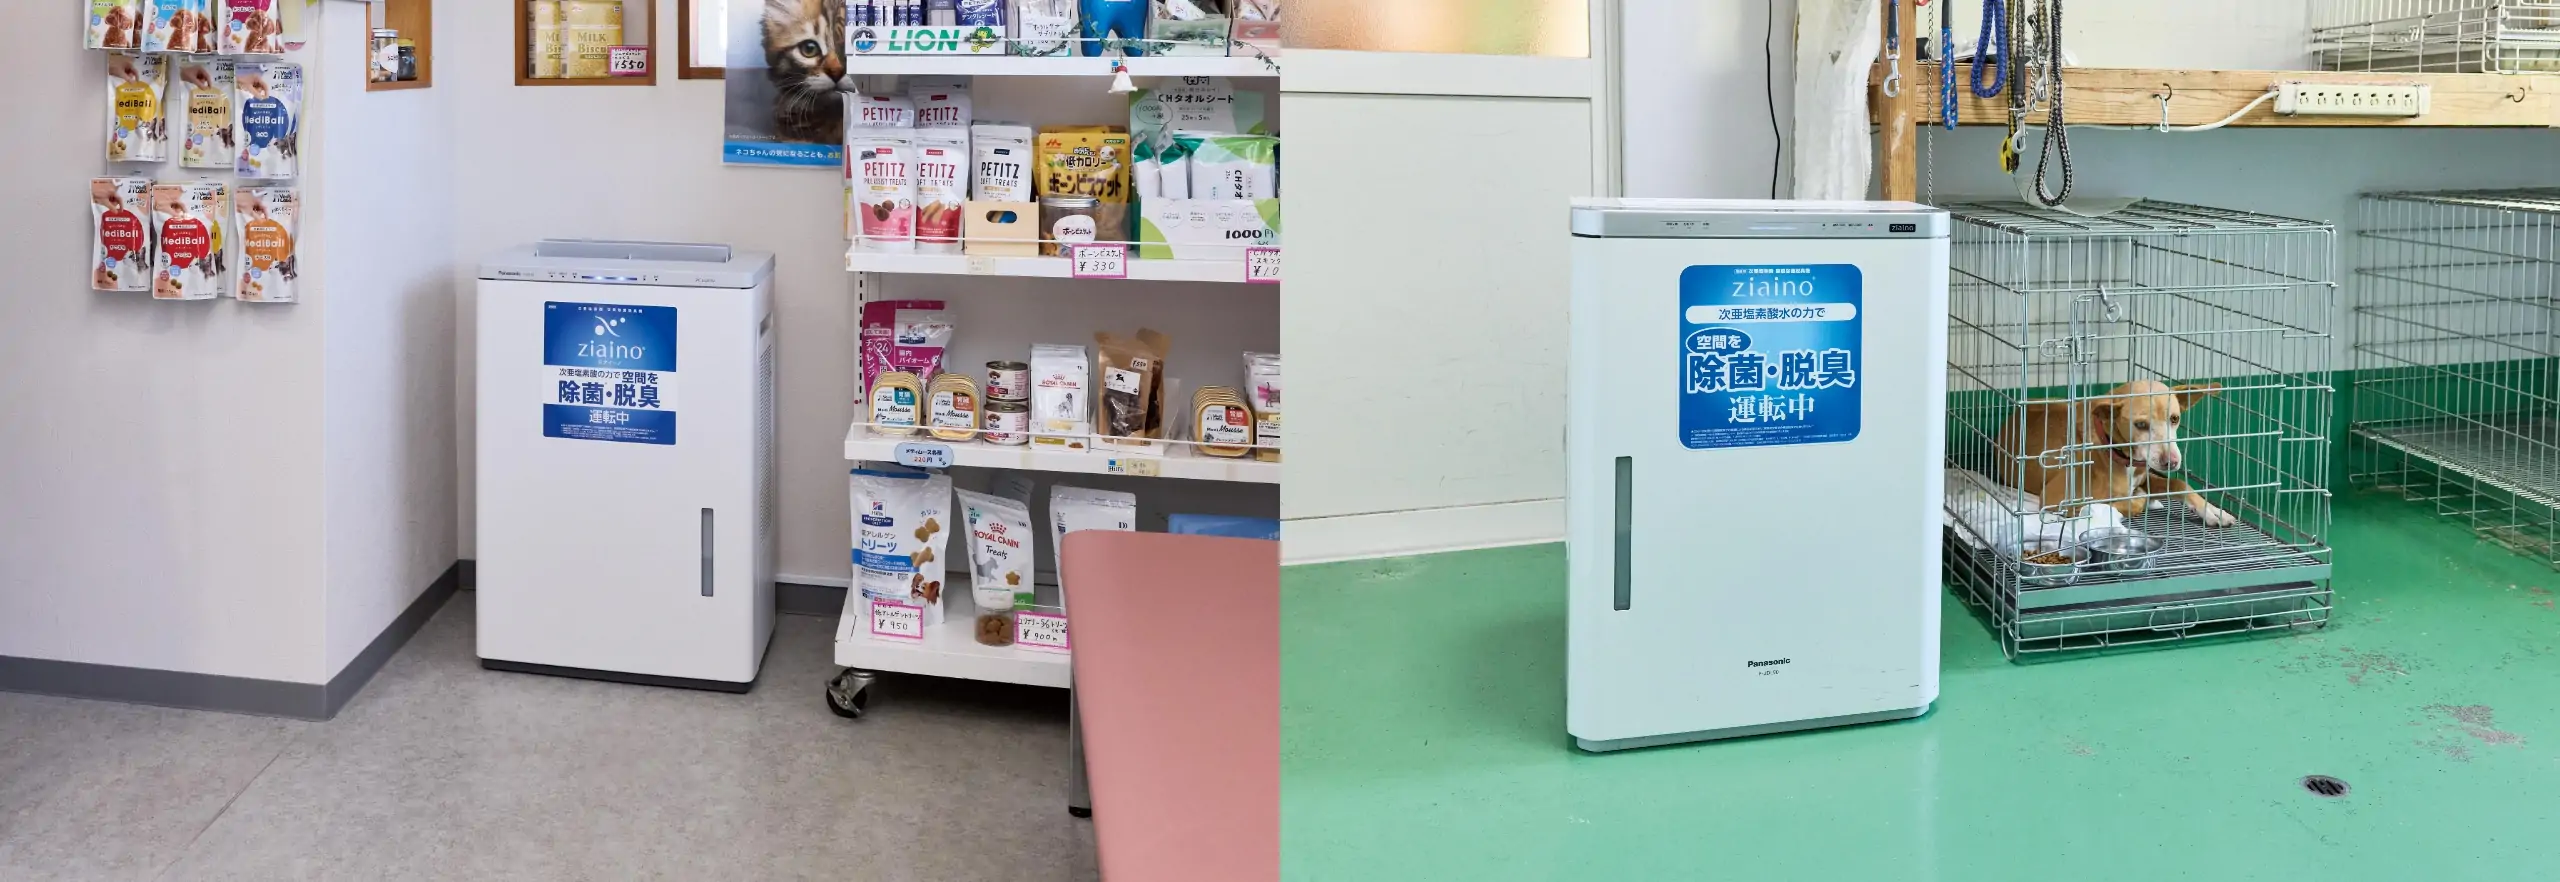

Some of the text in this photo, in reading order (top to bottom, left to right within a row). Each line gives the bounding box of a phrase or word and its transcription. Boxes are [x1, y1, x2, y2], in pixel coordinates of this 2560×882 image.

[545, 33, 561, 42] MI
[577, 33, 607, 42] MILK
[888, 29, 960, 51] LION
[578, 44, 609, 53] Biscu
[614, 60, 645, 70] ¥550
[119, 99, 152, 108] ediBall
[1158, 94, 1235, 104] CHタオルシート
[863, 107, 903, 121] PETITZ
[919, 107, 959, 122] PETITZ
[864, 162, 905, 177] PETITZ
[1066, 156, 1107, 168] 低カロリー
[917, 163, 956, 179] ETITZ
[981, 162, 1020, 179] PETITZ
[1078, 248, 1124, 258] ボーンビスケット
[1732, 277, 1814, 297] ziaino
[1718, 307, 1826, 321] 次亜塩素酸水の力で
[1696, 334, 1742, 350] 空間を
[577, 340, 643, 360] ziaino
[559, 368, 659, 385] 次亜塩素酸の力で 空間を
[1688, 349, 1854, 392] 除菌・脱臭
[558, 380, 661, 409] 除菌・脱臭
[889, 405, 911, 413] Mousse
[946, 410, 970, 418] Mousse
[1728, 393, 1815, 424] 運転中
[589, 409, 630, 426] 運転中
[1219, 425, 1244, 434] Mousse
[861, 538, 897, 553] トリーツ
[974, 530, 1019, 549] ROYAL CANIN
[986, 545, 1008, 560] Treats
[1747, 657, 1791, 668] Panasonic
